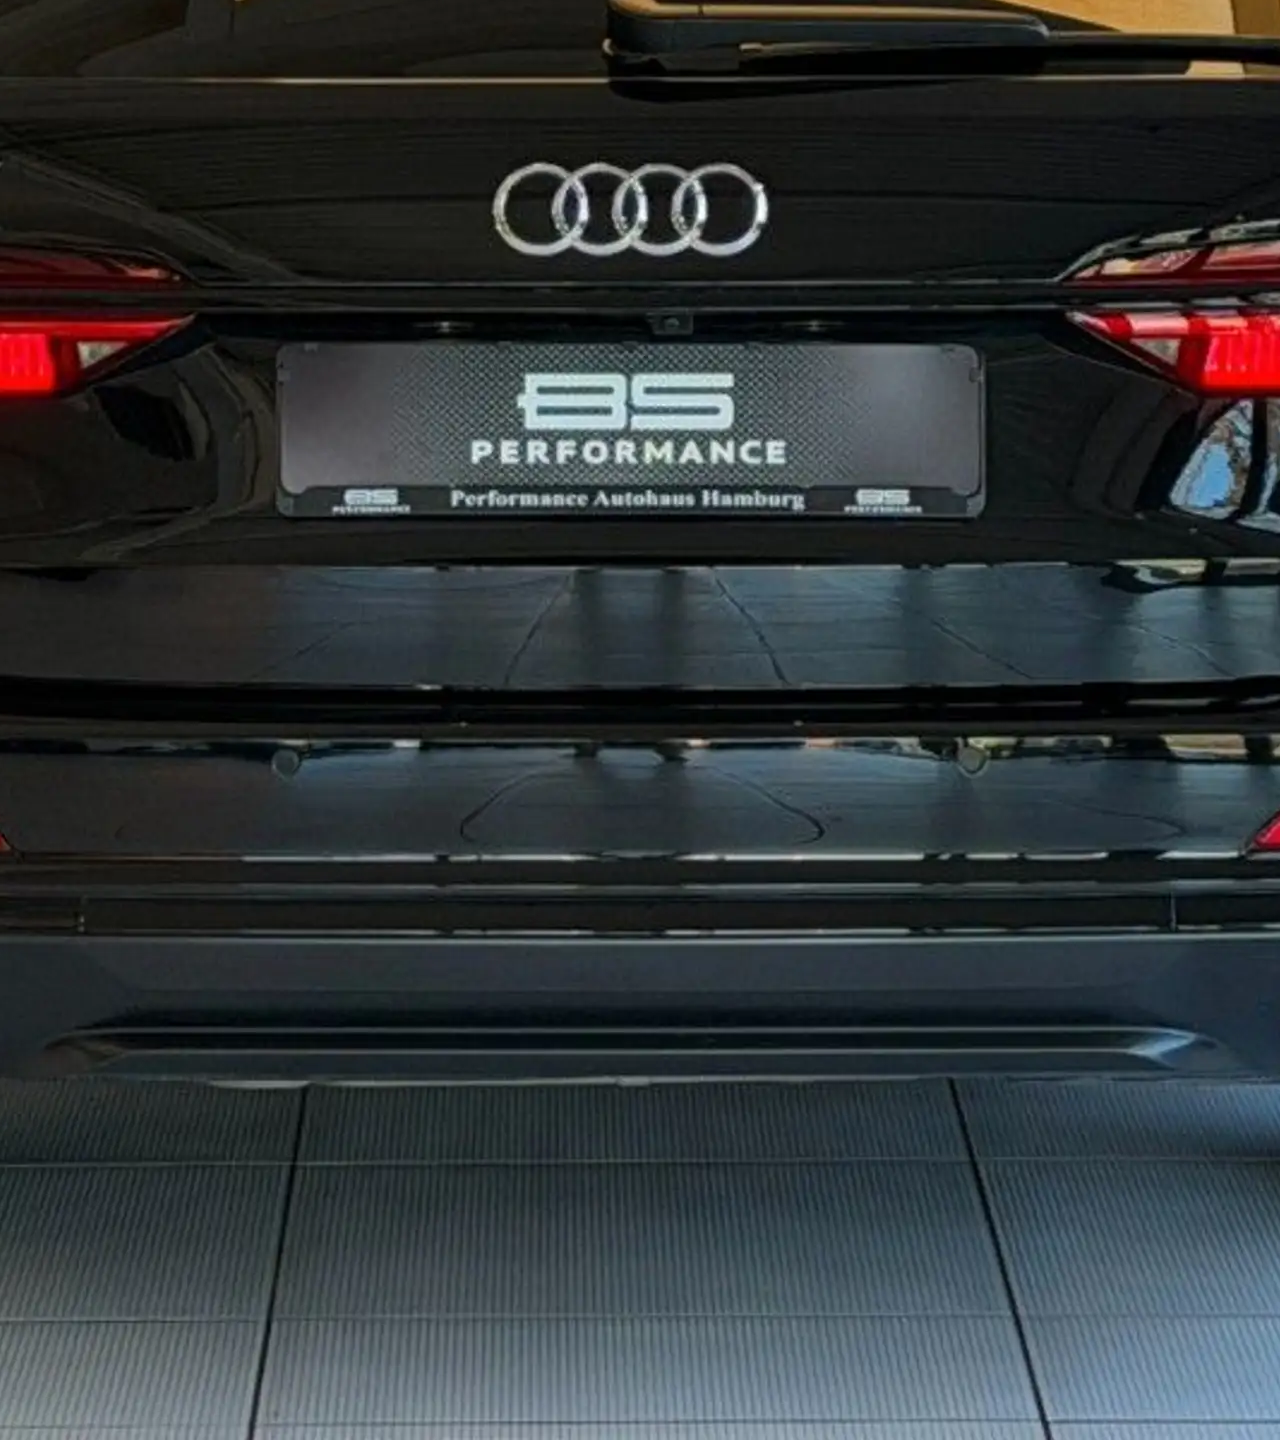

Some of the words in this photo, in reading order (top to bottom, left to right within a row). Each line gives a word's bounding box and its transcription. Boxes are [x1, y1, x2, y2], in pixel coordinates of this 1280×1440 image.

[517, 373, 735, 432] BS
[470, 439, 787, 465] PERFORMANCE
[450, 489, 589, 507] Performance
[593, 489, 695, 507] Autohaus
[702, 489, 805, 511] Hamburg
